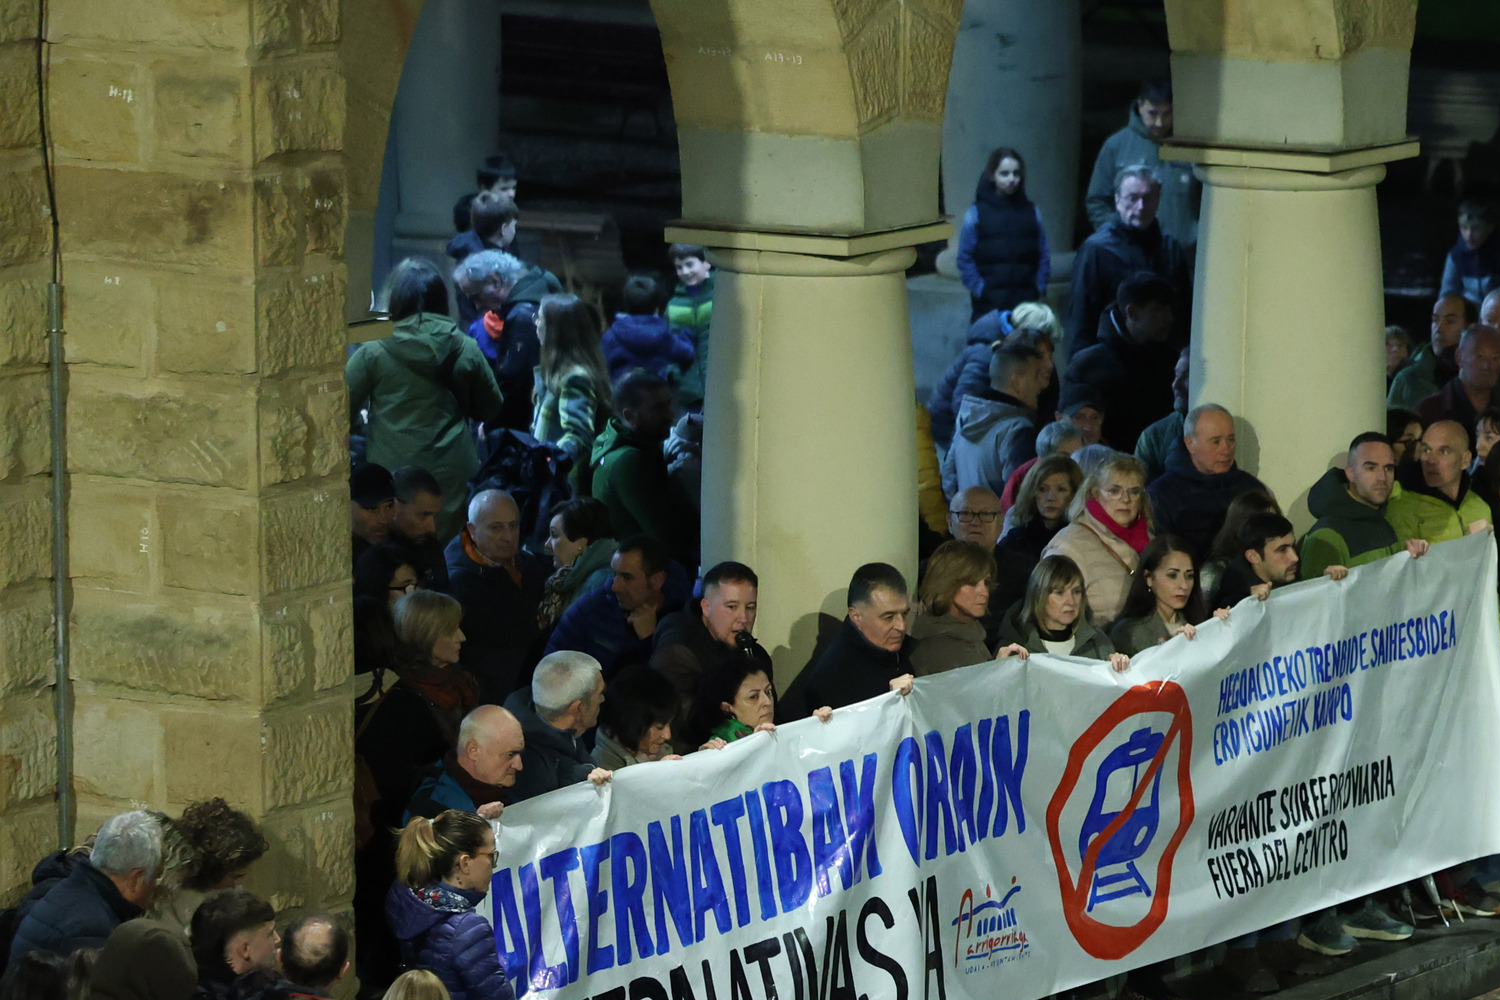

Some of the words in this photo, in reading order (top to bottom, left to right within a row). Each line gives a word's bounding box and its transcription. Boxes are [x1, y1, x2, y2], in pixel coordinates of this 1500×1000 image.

[1217, 650, 1307, 717] HEGOALDEKO
[1306, 632, 1369, 685] TRENBIDE
[1370, 610, 1457, 668] SAIHESBIDEA
[1208, 789, 1277, 849] VARIANTE
[1280, 781, 1314, 830] SUR
[1309, 755, 1396, 819] FERROVIARIA
[491, 752, 883, 1000] ALTERNATIBAK
[892, 709, 1031, 868] ORAIN
[1207, 847, 1265, 899] FUERA
[1262, 838, 1291, 884] DEL
[1294, 819, 1348, 876] CENTRO
